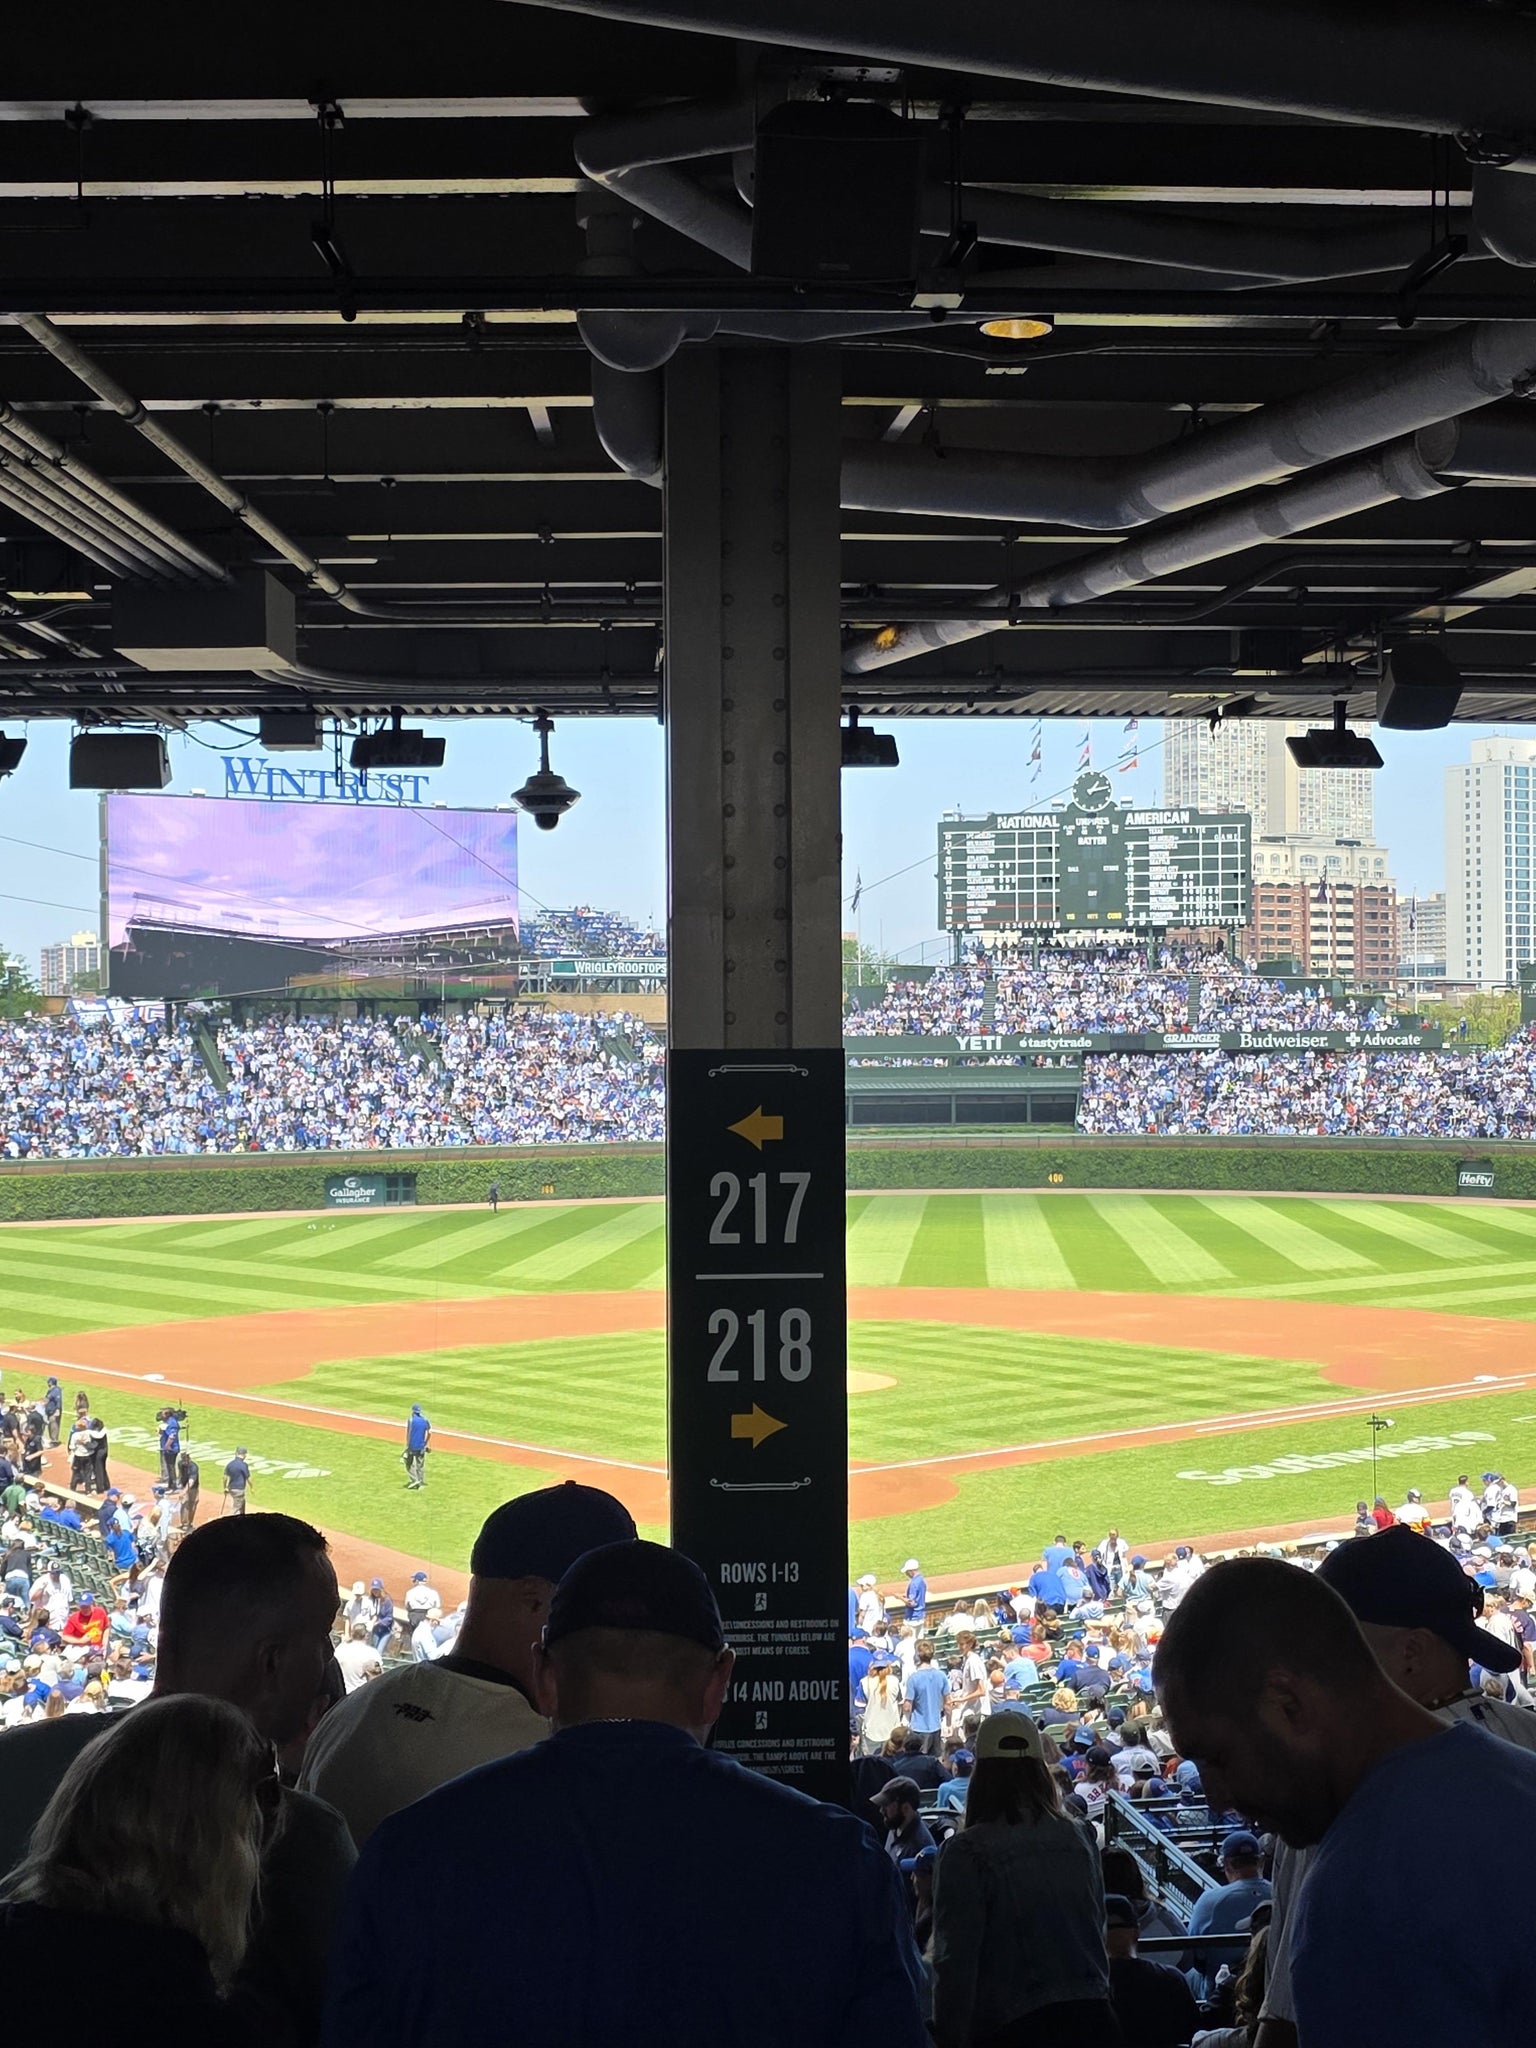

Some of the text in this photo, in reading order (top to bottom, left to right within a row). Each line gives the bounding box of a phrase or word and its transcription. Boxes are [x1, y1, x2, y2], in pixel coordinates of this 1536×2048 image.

[220, 756, 430, 803] WINTRUST
[997, 815, 1060, 829] NATIONAL
[1076, 817, 1110, 826] UMPIRES
[1125, 811, 1190, 825] AMERICAN
[1078, 836, 1107, 845] BATTER
[574, 962, 667, 974] WRIGLEYROOFTOPS
[956, 1036, 1003, 1050] YETI
[1029, 1037, 1092, 1050] tastytrade
[1163, 1033, 1220, 1043] GRAINGER
[1363, 1034, 1421, 1046] Advocate
[1048, 1173, 1064, 1183] 400
[1462, 1174, 1491, 1186] Hefty
[330, 1187, 376, 1198] Gallagher
[708, 1171, 811, 1244] 217
[707, 1307, 812, 1382] 218
[1176, 1436, 1478, 1486] Southwest
[721, 1561, 799, 1584] ROWS 1-13
[776, 1620, 789, 1628] AND
[790, 1620, 828, 1628] RESTROOMS
[830, 1619, 839, 1628] ON
[758, 1633, 769, 1642] THE
[771, 1633, 799, 1641] TUNNELS
[801, 1632, 822, 1641] BELOW
[824, 1632, 836, 1641] ARE
[752, 1646, 774, 1655] MEANS
[775, 1646, 783, 1655] OF
[733, 1682, 748, 1702] 14
[752, 1681, 784, 1701] AND
[789, 1680, 840, 1701] ABOVE
[737, 1739, 780, 1748] CONCESSIONS
[782, 1739, 795, 1747] AND
[796, 1738, 835, 1747] RESTROOMS
[753, 1753, 764, 1761] THE
[810, 1752, 822, 1760] ARE
[824, 1752, 836, 1760] THE
